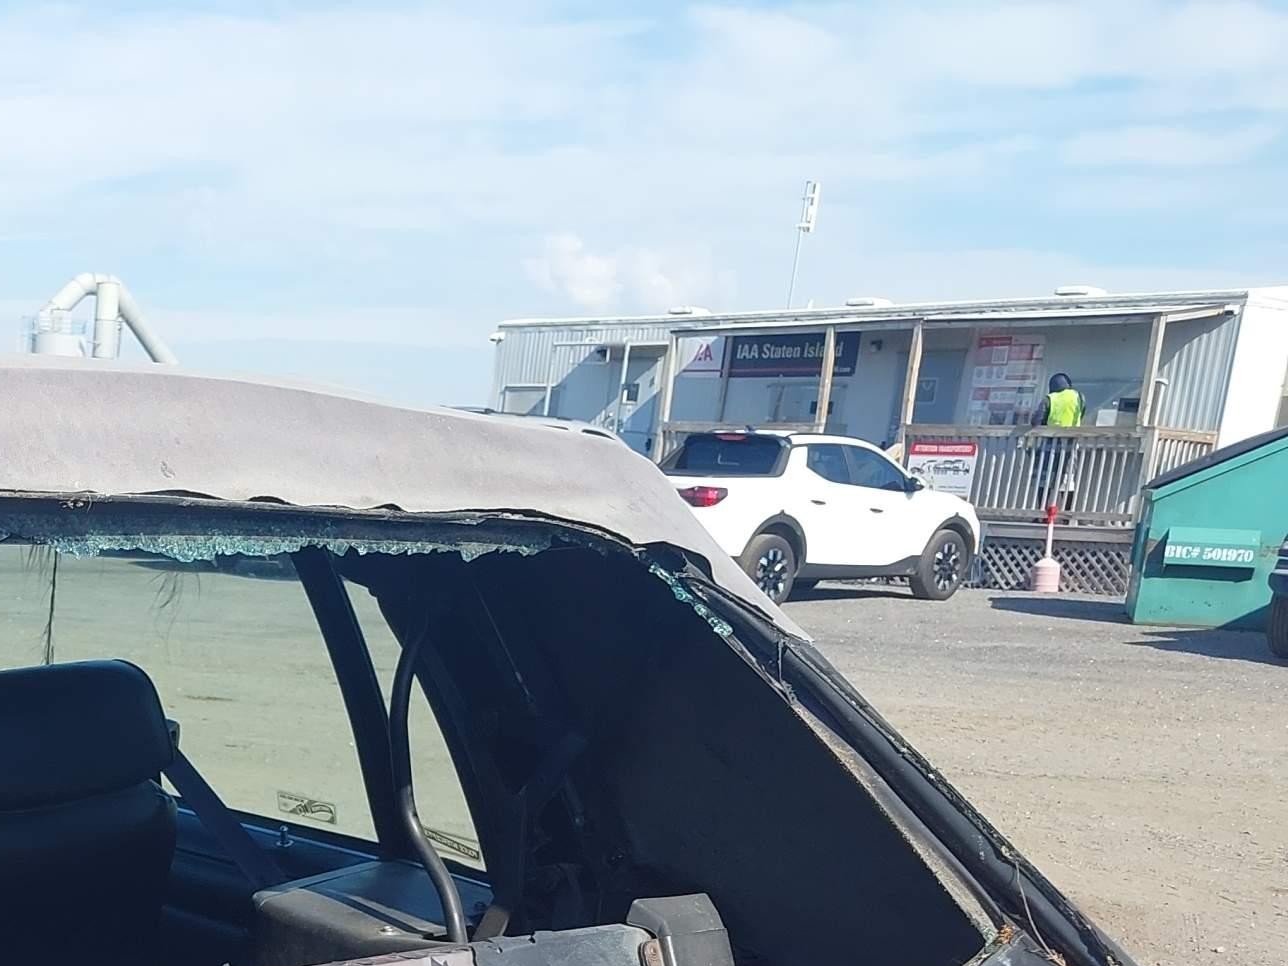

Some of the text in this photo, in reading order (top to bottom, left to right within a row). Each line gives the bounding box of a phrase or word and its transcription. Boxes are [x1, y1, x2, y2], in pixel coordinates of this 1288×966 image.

[736, 344, 759, 360] IAA
[761, 343, 801, 359] Staten
[1164, 544, 1254, 563] BIC# 501970
